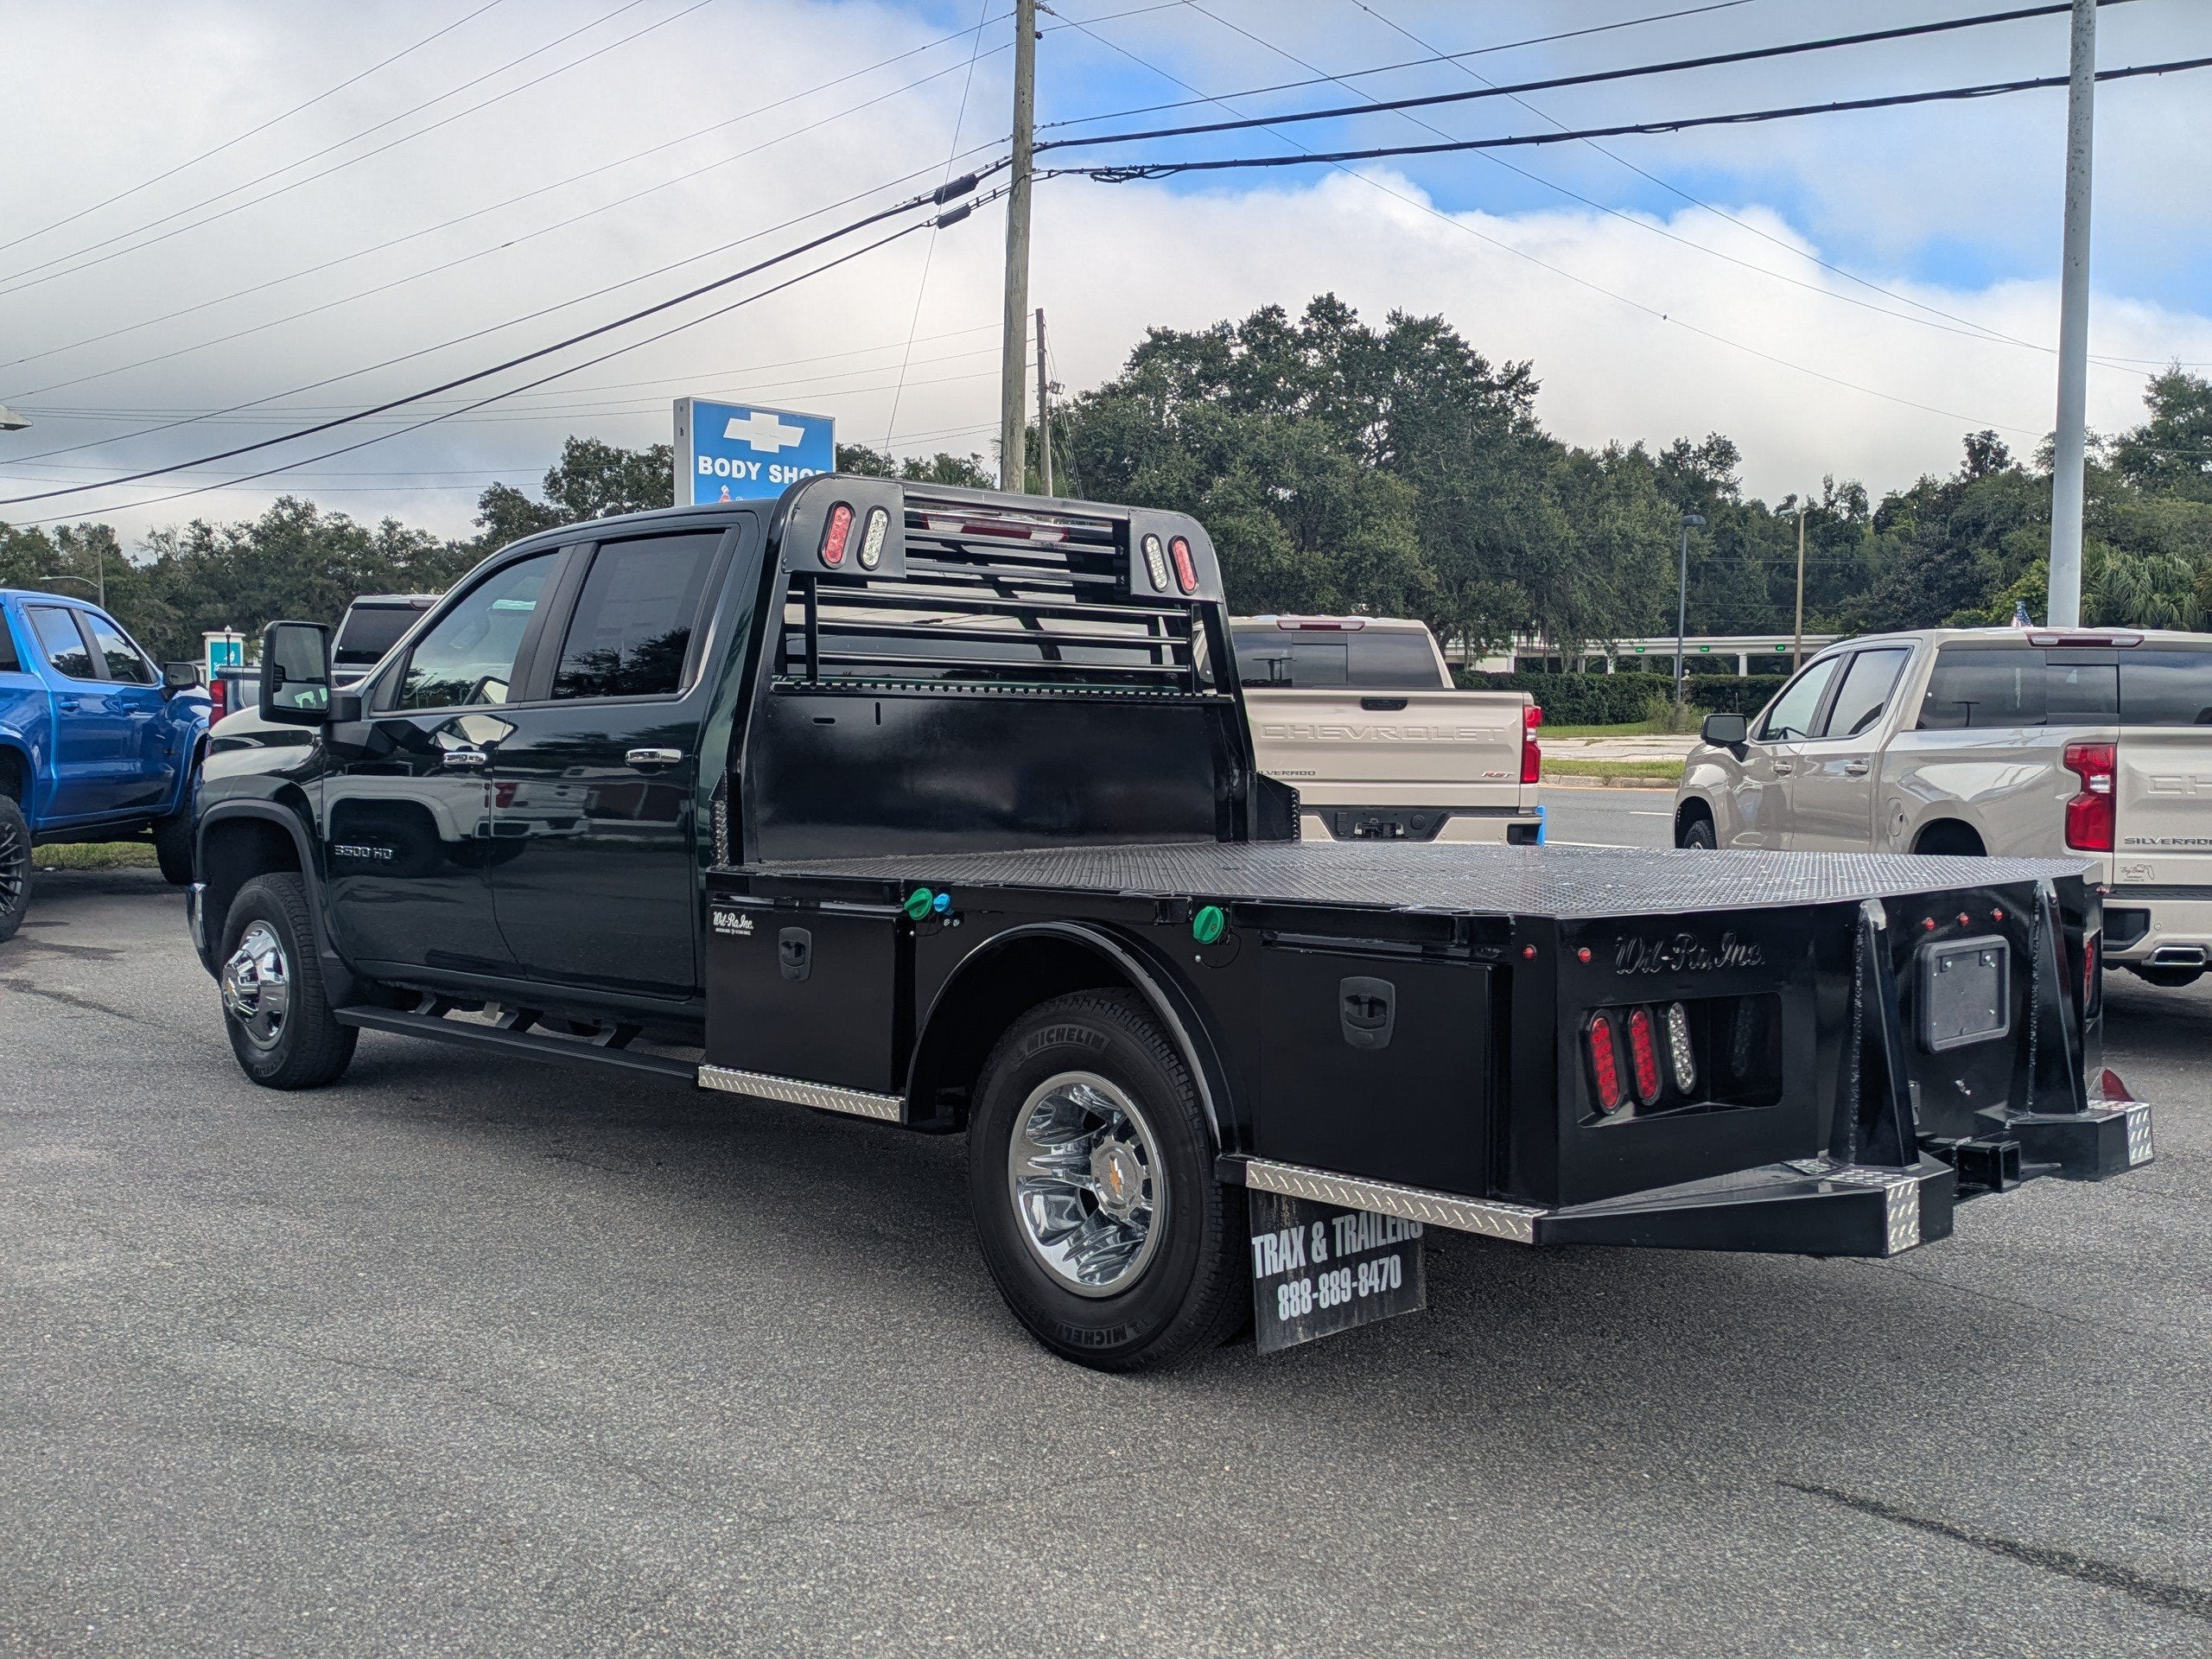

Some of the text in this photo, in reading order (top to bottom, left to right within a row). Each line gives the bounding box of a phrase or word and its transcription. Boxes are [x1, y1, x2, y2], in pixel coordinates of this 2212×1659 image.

[698, 455, 826, 484] BODY SHO
[1260, 724, 1505, 741] CHEVROLET
[334, 845, 393, 860] 3500 HD
[1027, 1027, 1106, 1051] MICHELIN
[1251, 1224, 1307, 1279] TRAX
[1311, 1220, 1329, 1264] &
[1277, 1254, 1402, 1321] 888-889-8470
